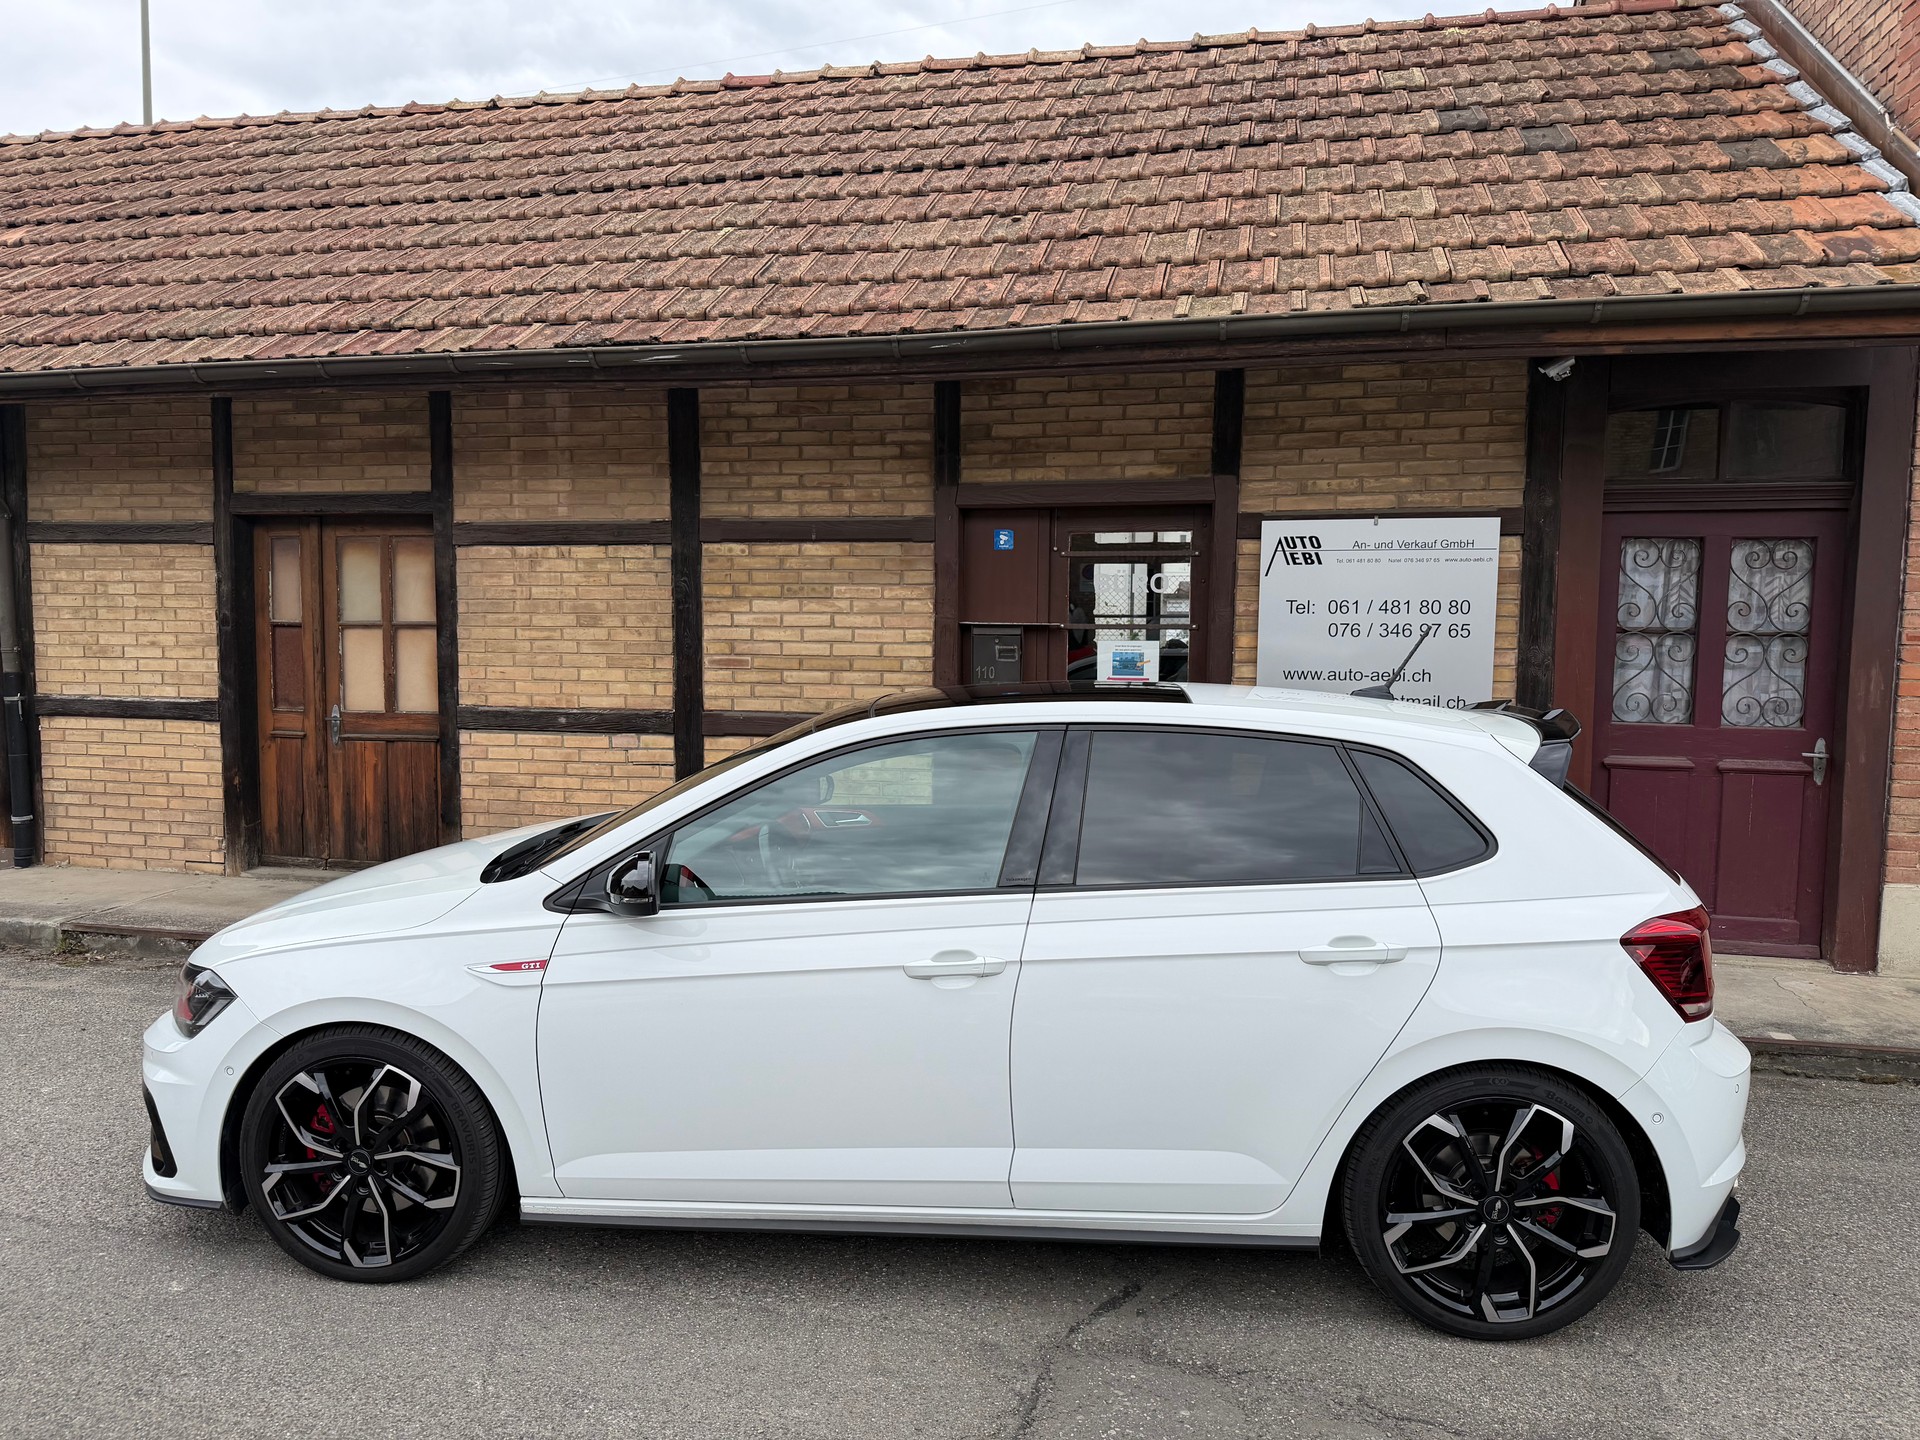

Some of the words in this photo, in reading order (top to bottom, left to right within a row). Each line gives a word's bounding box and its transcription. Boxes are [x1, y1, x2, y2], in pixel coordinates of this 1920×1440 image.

[1352, 540, 1371, 549] An-
[1374, 540, 1393, 549] und
[1397, 539, 1437, 549] Verkauf
[1440, 539, 1475, 548] GmbH
[1286, 600, 1315, 614] Tel:
[1328, 600, 1358, 615] 061
[1367, 600, 1373, 614] /
[1379, 600, 1410, 615] 481
[1419, 600, 1441, 615] 80
[1448, 600, 1471, 615] 80
[1328, 623, 1360, 638] 076
[1367, 623, 1373, 637] /
[1379, 623, 1412, 638] 346
[1419, 623, 1441, 638] 97
[1448, 623, 1471, 638] 65
[975, 665, 995, 679] 110
[1283, 668, 1431, 683] www.auto-aebi.ch
[1545, 1089, 1585, 1119] Barum
[451, 1102, 477, 1164] BRAVURIS
